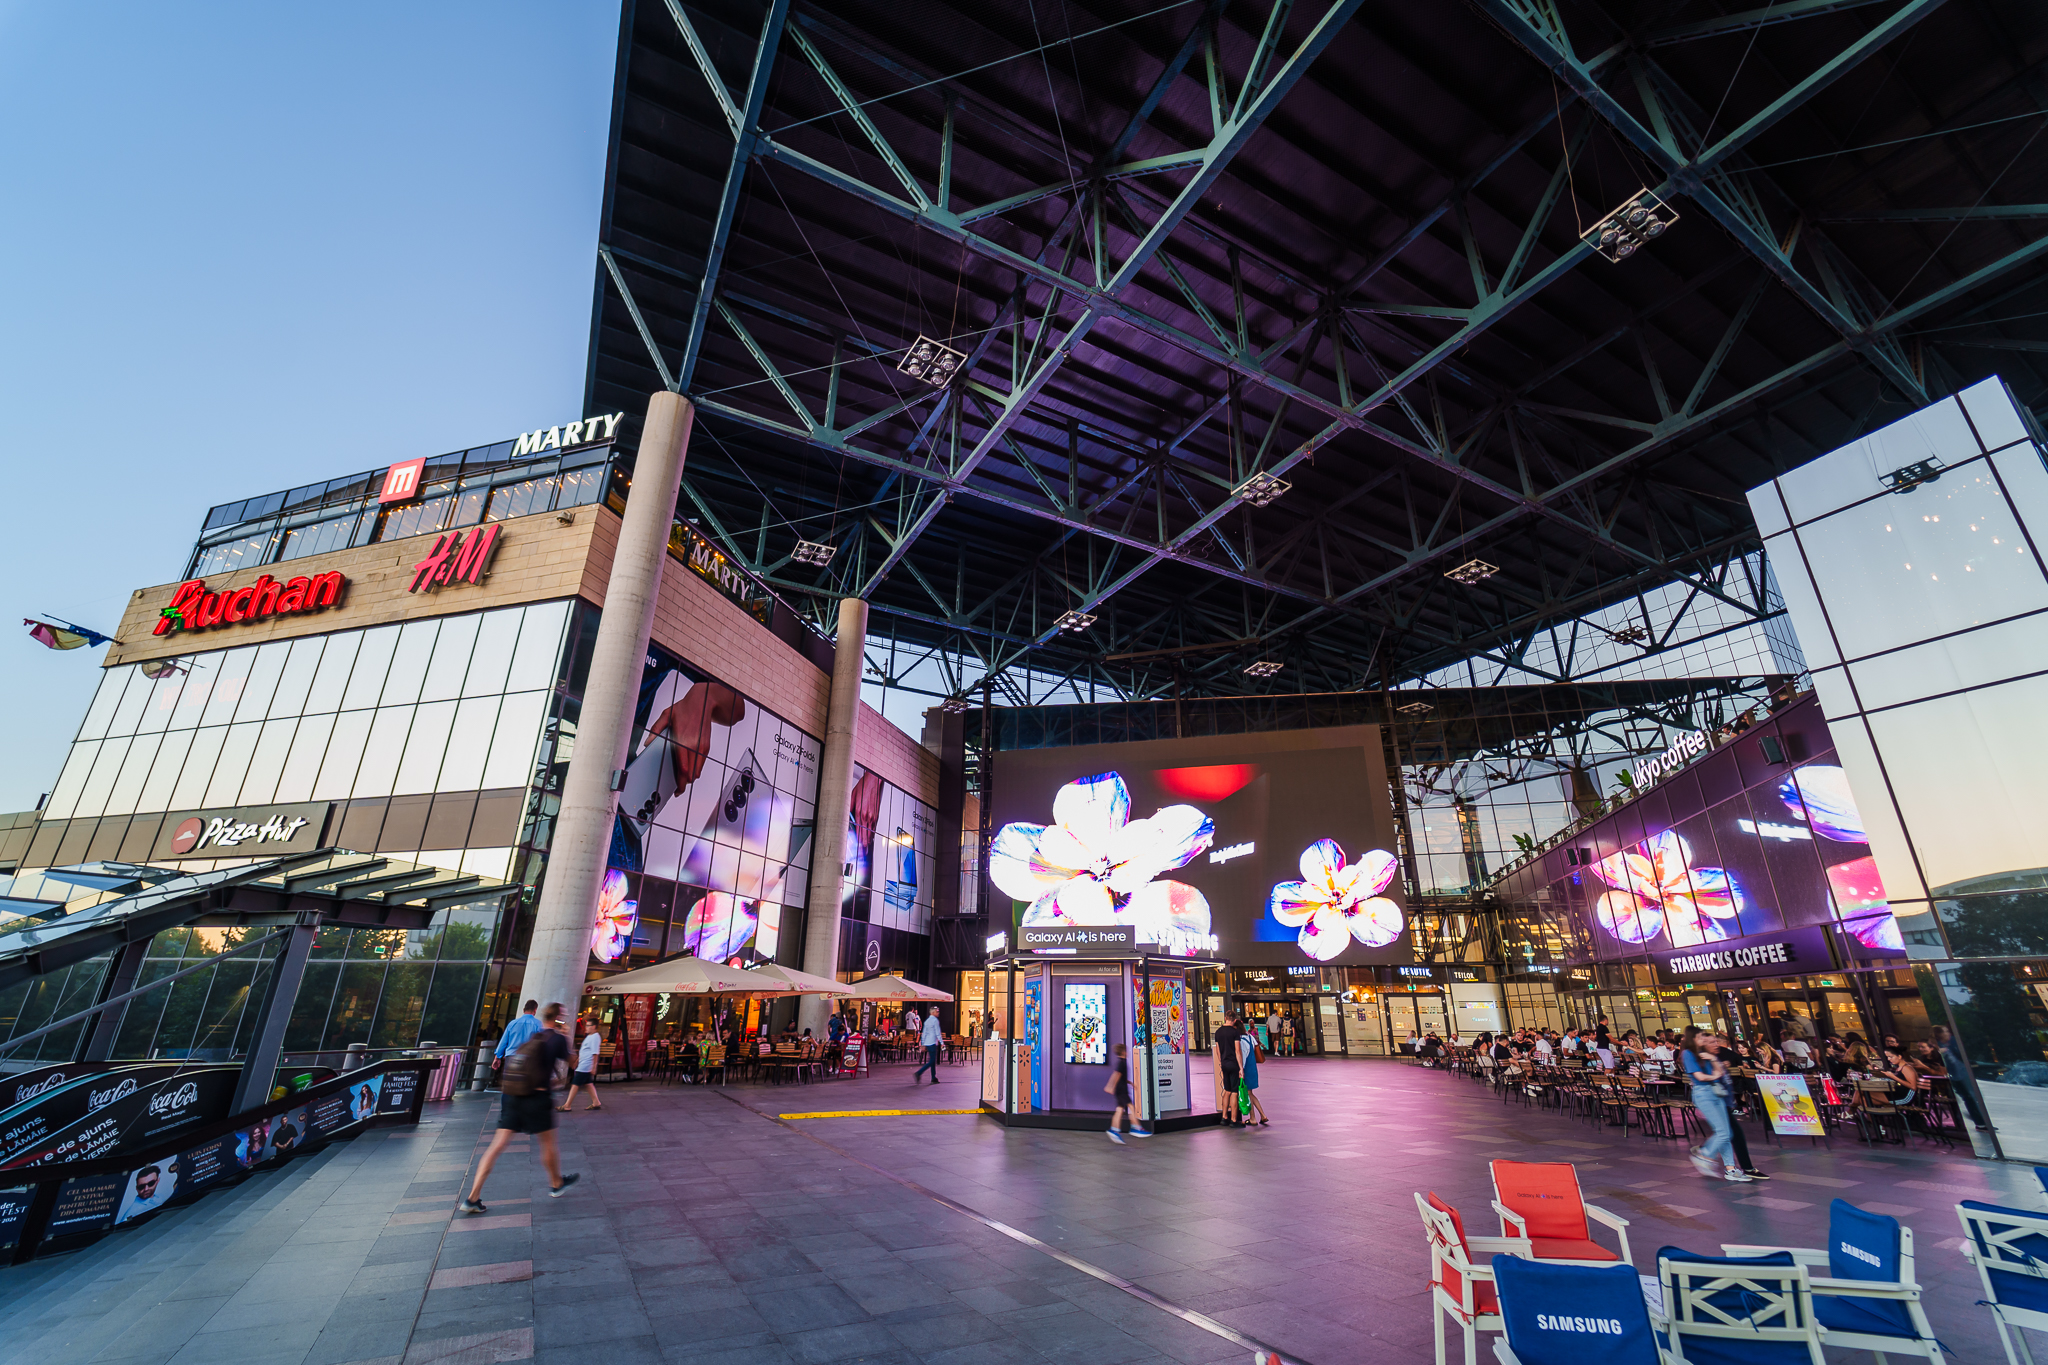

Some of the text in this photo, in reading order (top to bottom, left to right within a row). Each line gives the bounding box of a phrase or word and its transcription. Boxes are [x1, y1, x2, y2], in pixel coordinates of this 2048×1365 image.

[512, 412, 624, 458] MARTY
[408, 524, 502, 594] H&M
[692, 542, 750, 602] MARTY
[152, 570, 346, 636] Auchan
[774, 733, 796, 754] Galaxy
[1631, 729, 1706, 790] ukyo coffee
[197, 814, 308, 850] Pizza Hut
[1026, 932, 1127, 946] Galaxy AI is here
[1670, 943, 1788, 974] STARBUCKS COFFEE
[1244, 970, 1268, 979] TEILOR
[1454, 972, 1474, 980] TEILOR
[404, 1080, 418, 1088] FEST
[148, 1082, 198, 1116] Coca-Cola
[1778, 1112, 1818, 1123] remix
[5, 1116, 46, 1142] ajuns.
[44, 1152, 54, 1161] e
[56, 1140, 76, 1154] de
[78, 1118, 117, 1142] ajuns.
[64, 1128, 120, 1163] de LĂMÂIE
[74, 1192, 105, 1202] FESTIVAL
[96, 1183, 117, 1192] MARE
[1517, 1192, 1535, 1200] Galaxy
[0, 1202, 16, 1211] der
[2, 1206, 28, 1218] FEST
[58, 1201, 88, 1211] PENTRU
[60, 1210, 75, 1218] DIN
[1841, 1241, 1881, 1268] SAMSUNG
[1537, 1314, 1623, 1335] SAMSUNG
